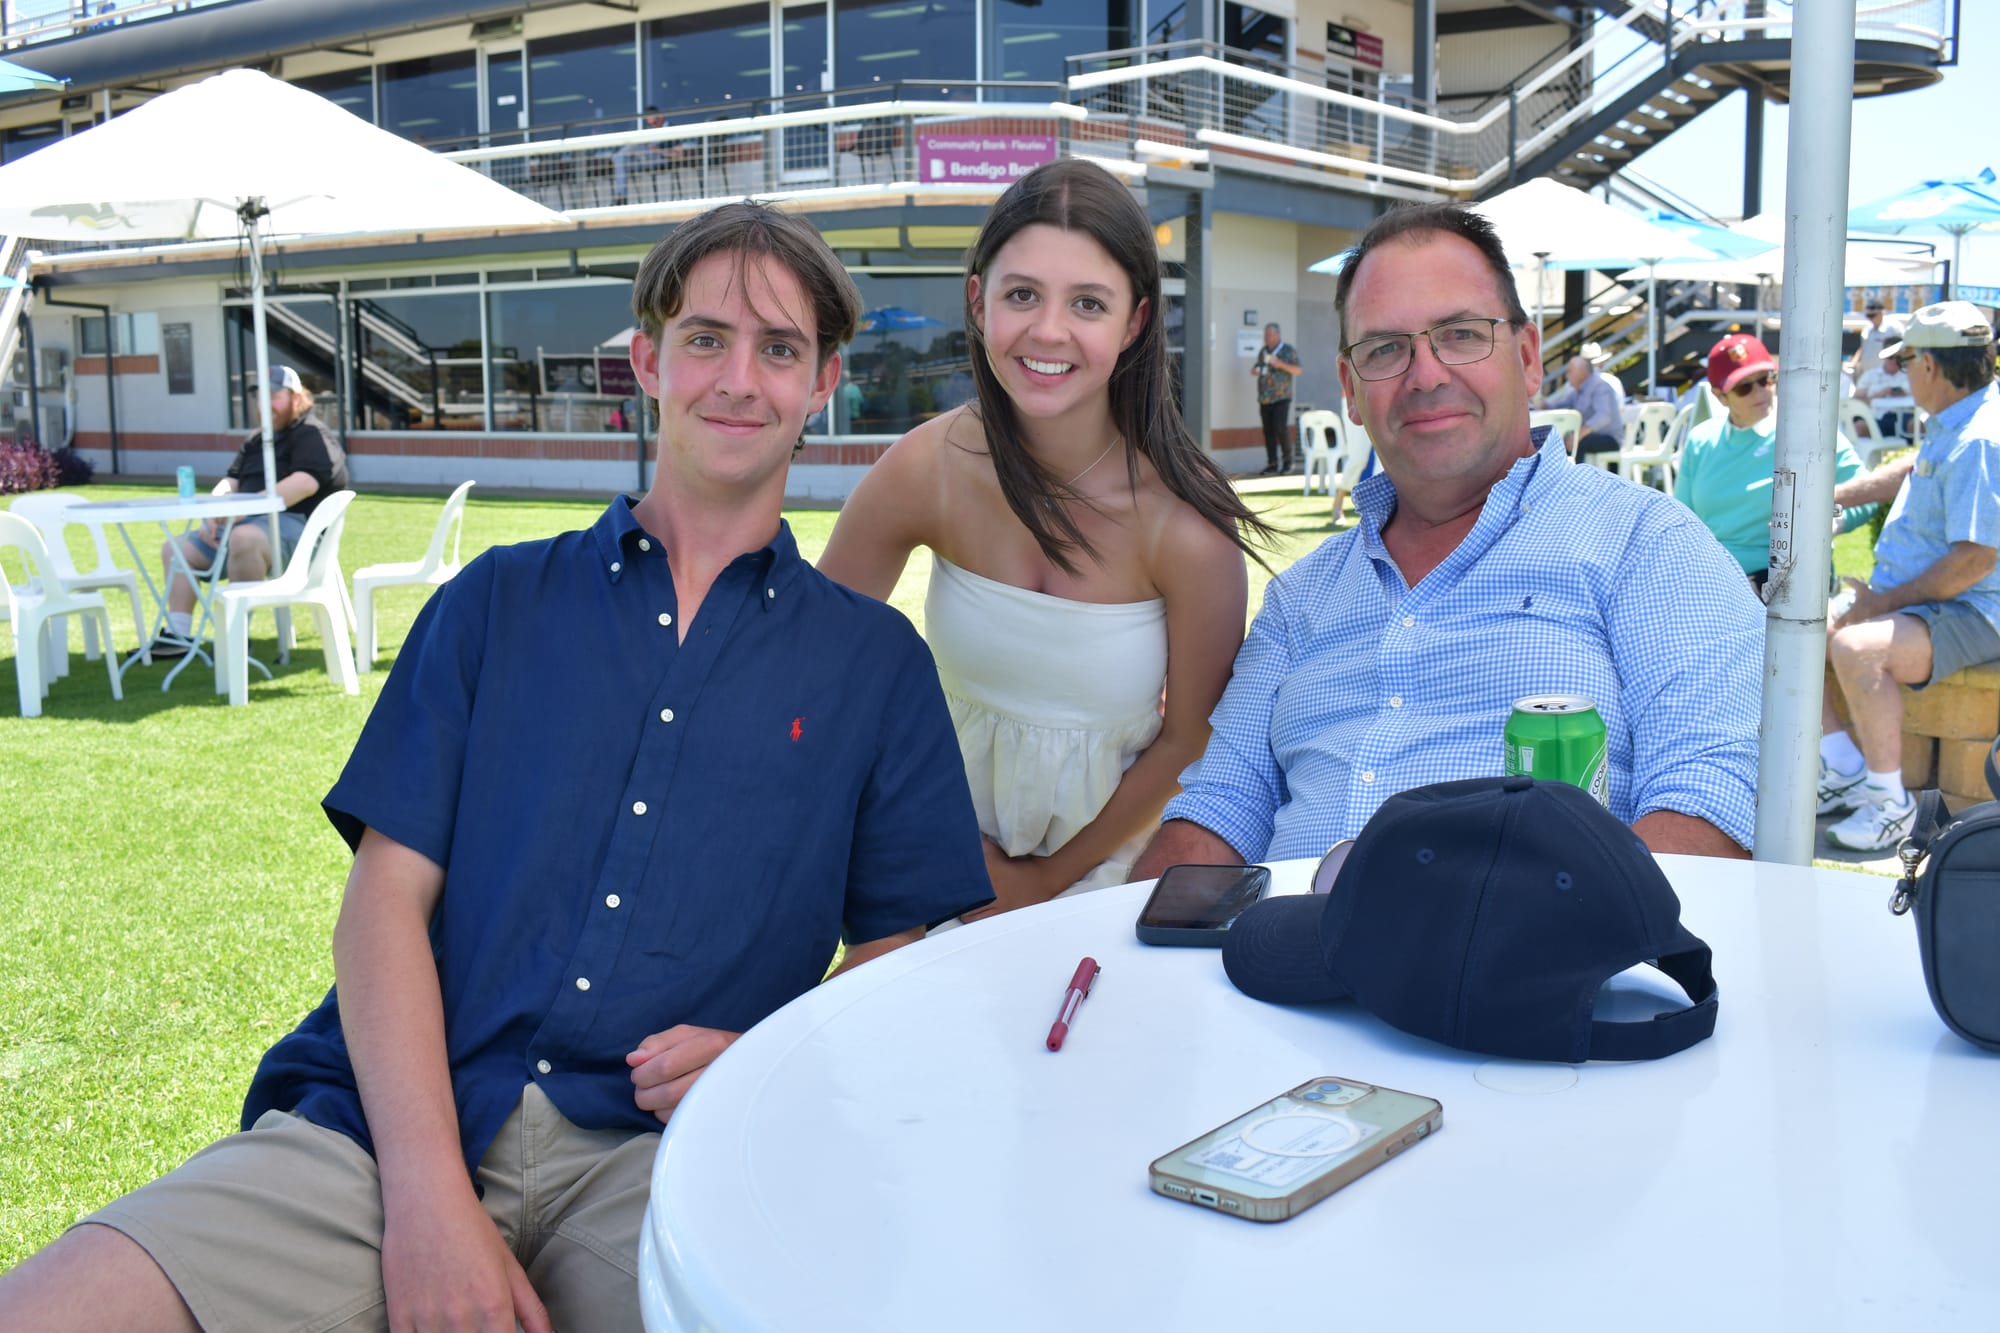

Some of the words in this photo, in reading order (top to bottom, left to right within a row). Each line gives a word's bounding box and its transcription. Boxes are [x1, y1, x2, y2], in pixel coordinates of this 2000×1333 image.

[927, 139, 981, 152] Community
[982, 140, 1007, 151] Bank
[950, 161, 1007, 180] Bendigo
